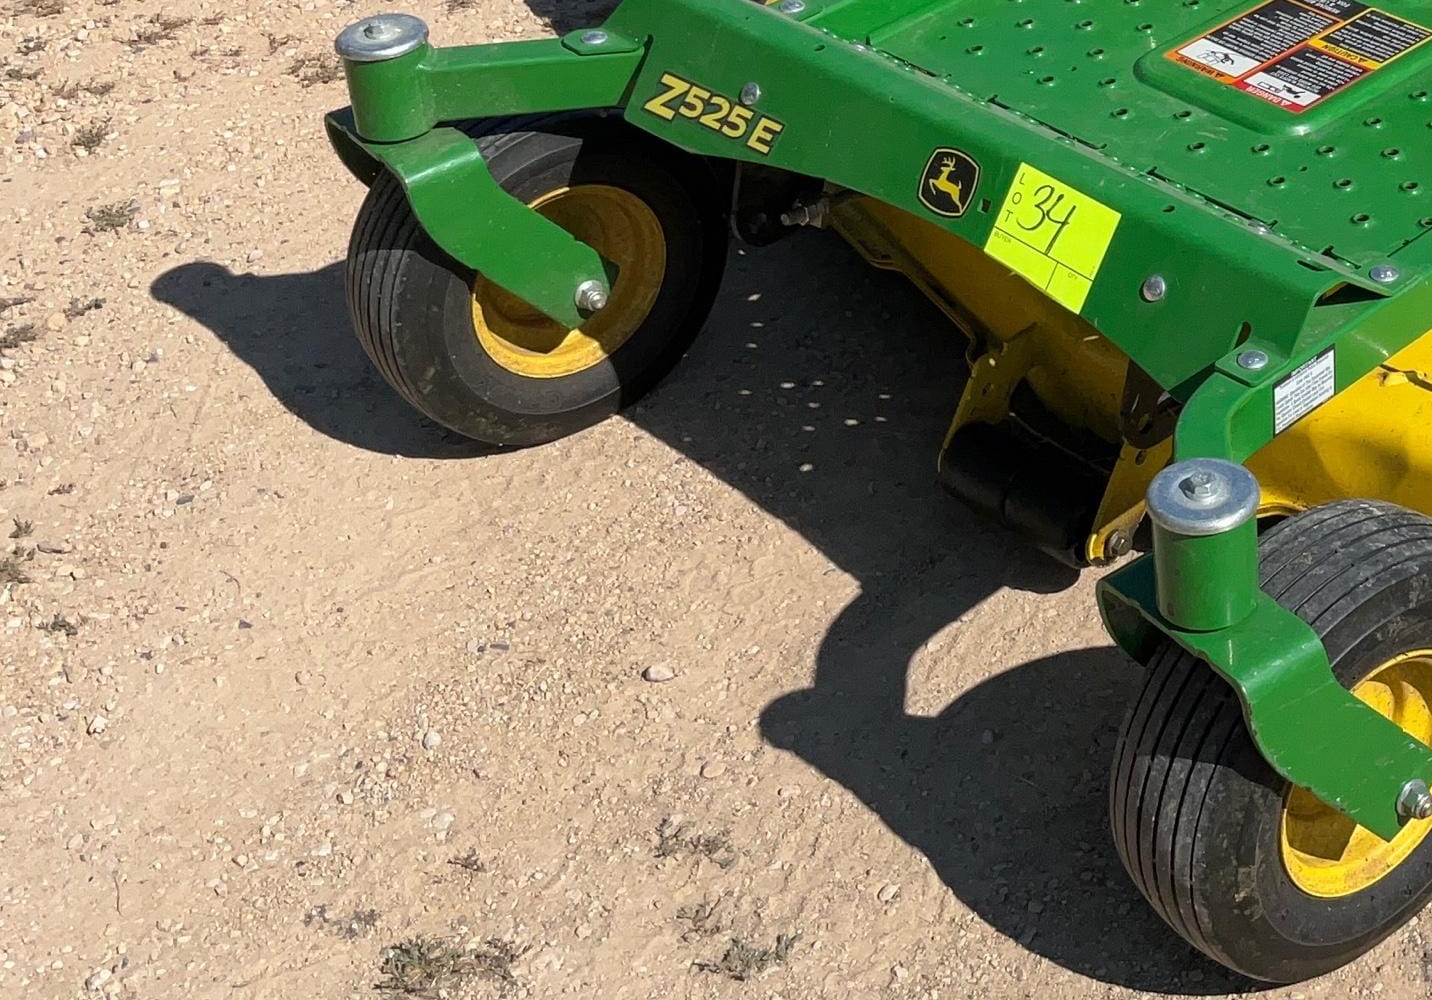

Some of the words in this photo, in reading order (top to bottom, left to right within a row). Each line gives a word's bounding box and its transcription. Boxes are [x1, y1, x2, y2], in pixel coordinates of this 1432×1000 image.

[1246, 85, 1282, 104] DANGER
[1005, 172, 1026, 222] LOT
[1016, 184, 1077, 256] 34
